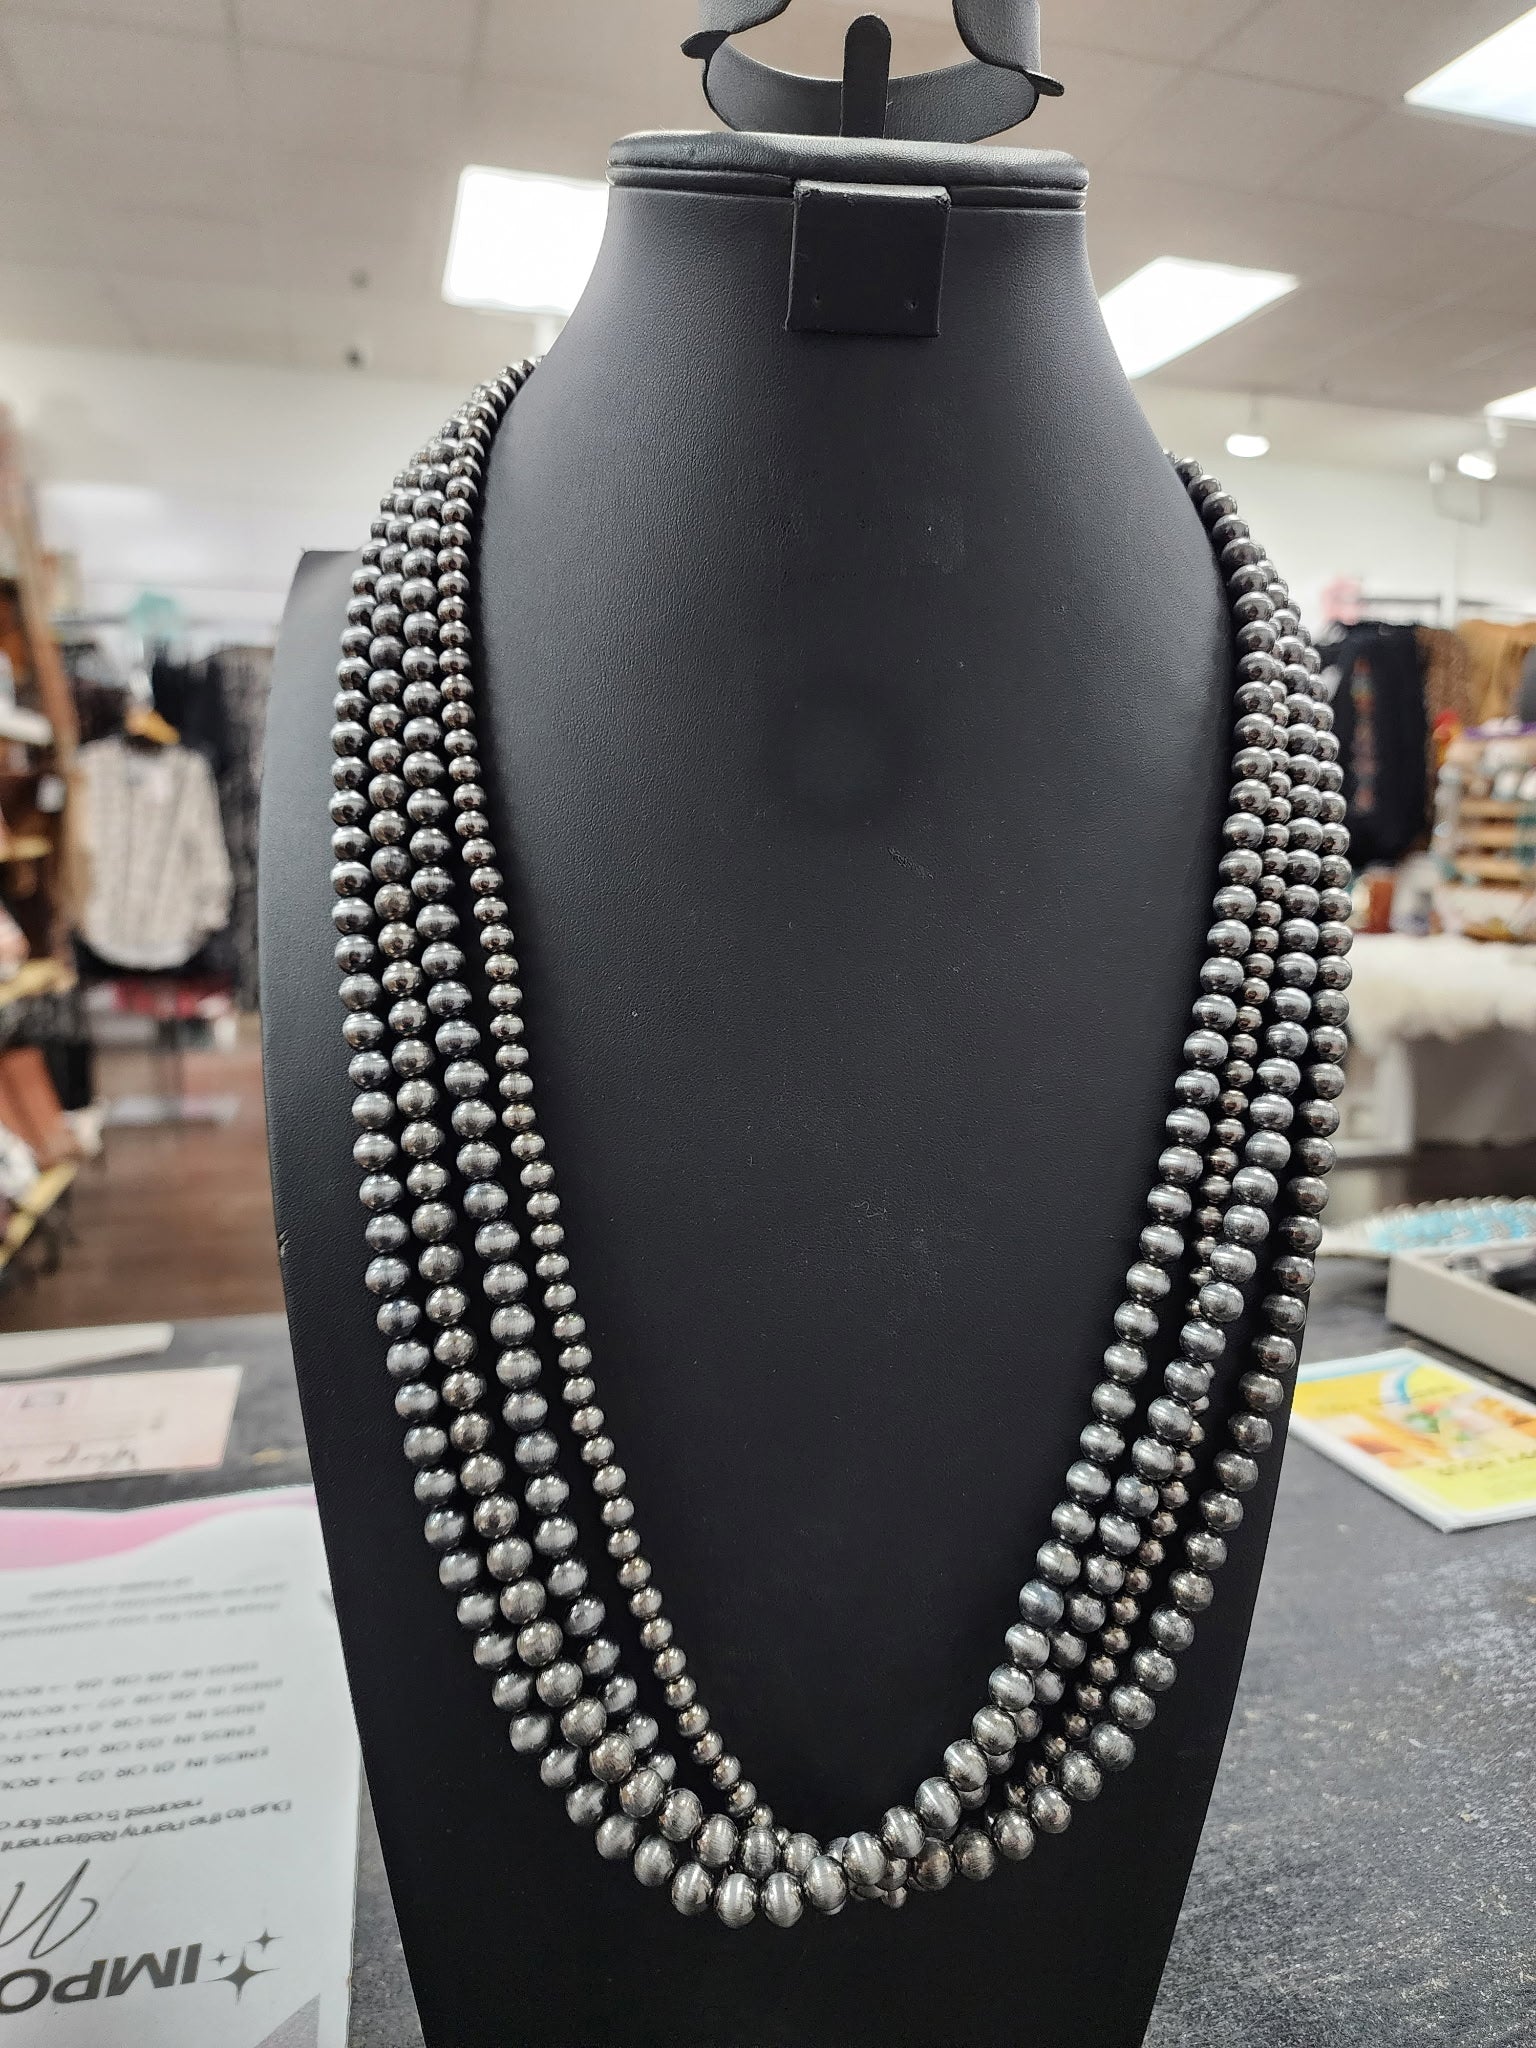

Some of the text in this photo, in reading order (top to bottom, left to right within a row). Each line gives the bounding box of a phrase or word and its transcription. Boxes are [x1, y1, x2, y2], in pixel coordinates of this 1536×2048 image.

[124, 1798, 203, 1818] nearest
[225, 1806, 246, 1819] to
[250, 1799, 291, 1816] Due
[16, 1816, 42, 1830] for
[45, 1811, 103, 1826] cents
[106, 1809, 120, 1822] 5
[188, 1811, 222, 1827] the
[119, 1820, 185, 1839] Penny
